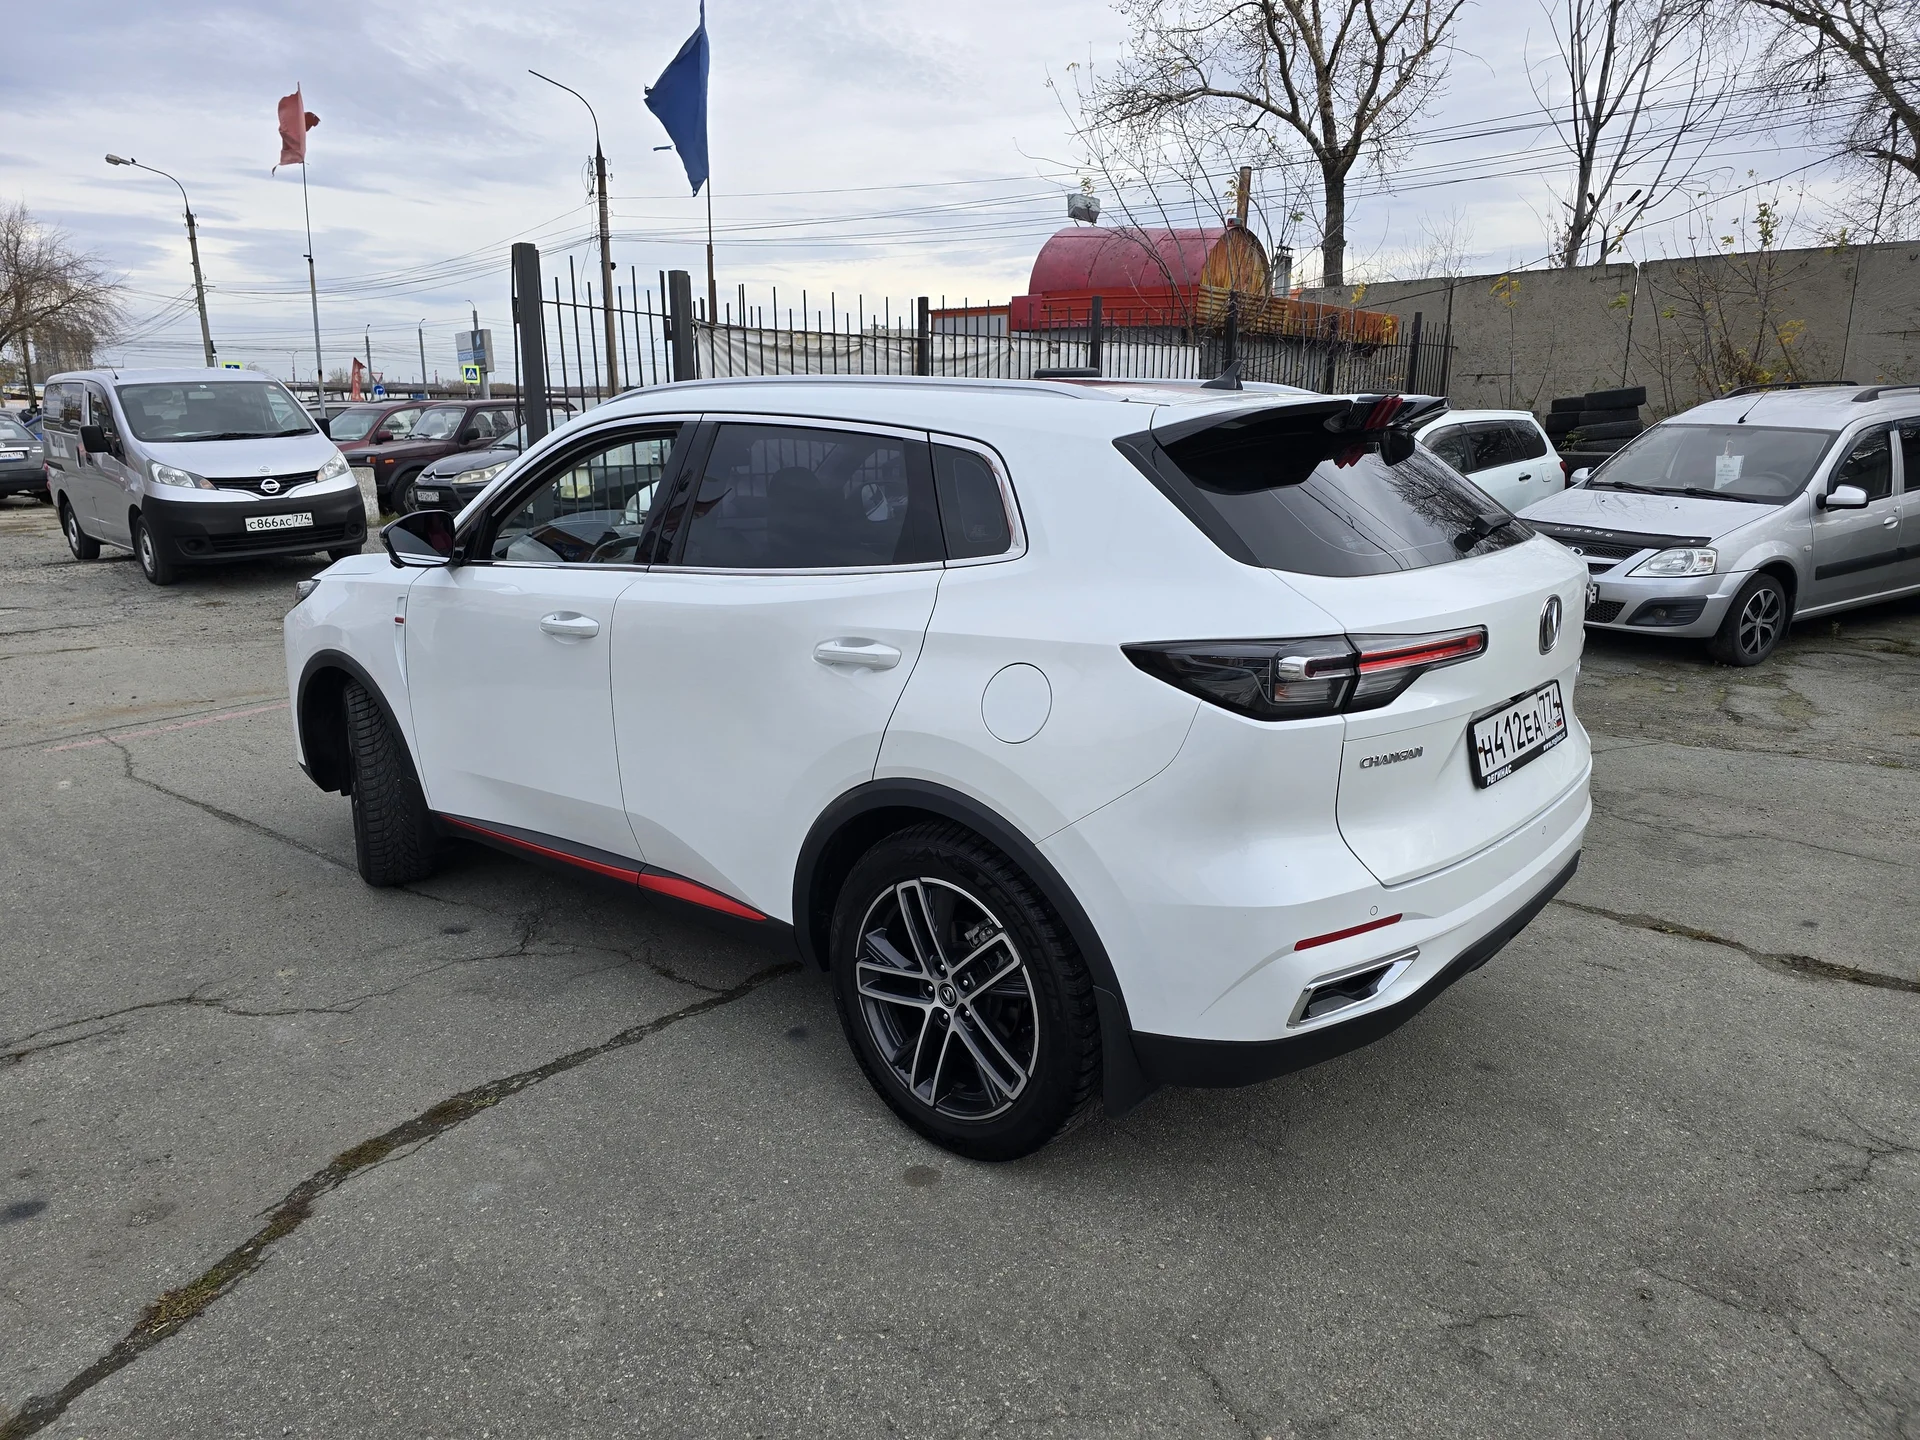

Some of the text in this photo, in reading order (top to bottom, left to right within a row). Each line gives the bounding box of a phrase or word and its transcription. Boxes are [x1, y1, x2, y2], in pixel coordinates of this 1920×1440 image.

[293, 514, 311, 523] 774
[1538, 688, 1561, 723] 774
[1360, 745, 1424, 769] CHANGAN
